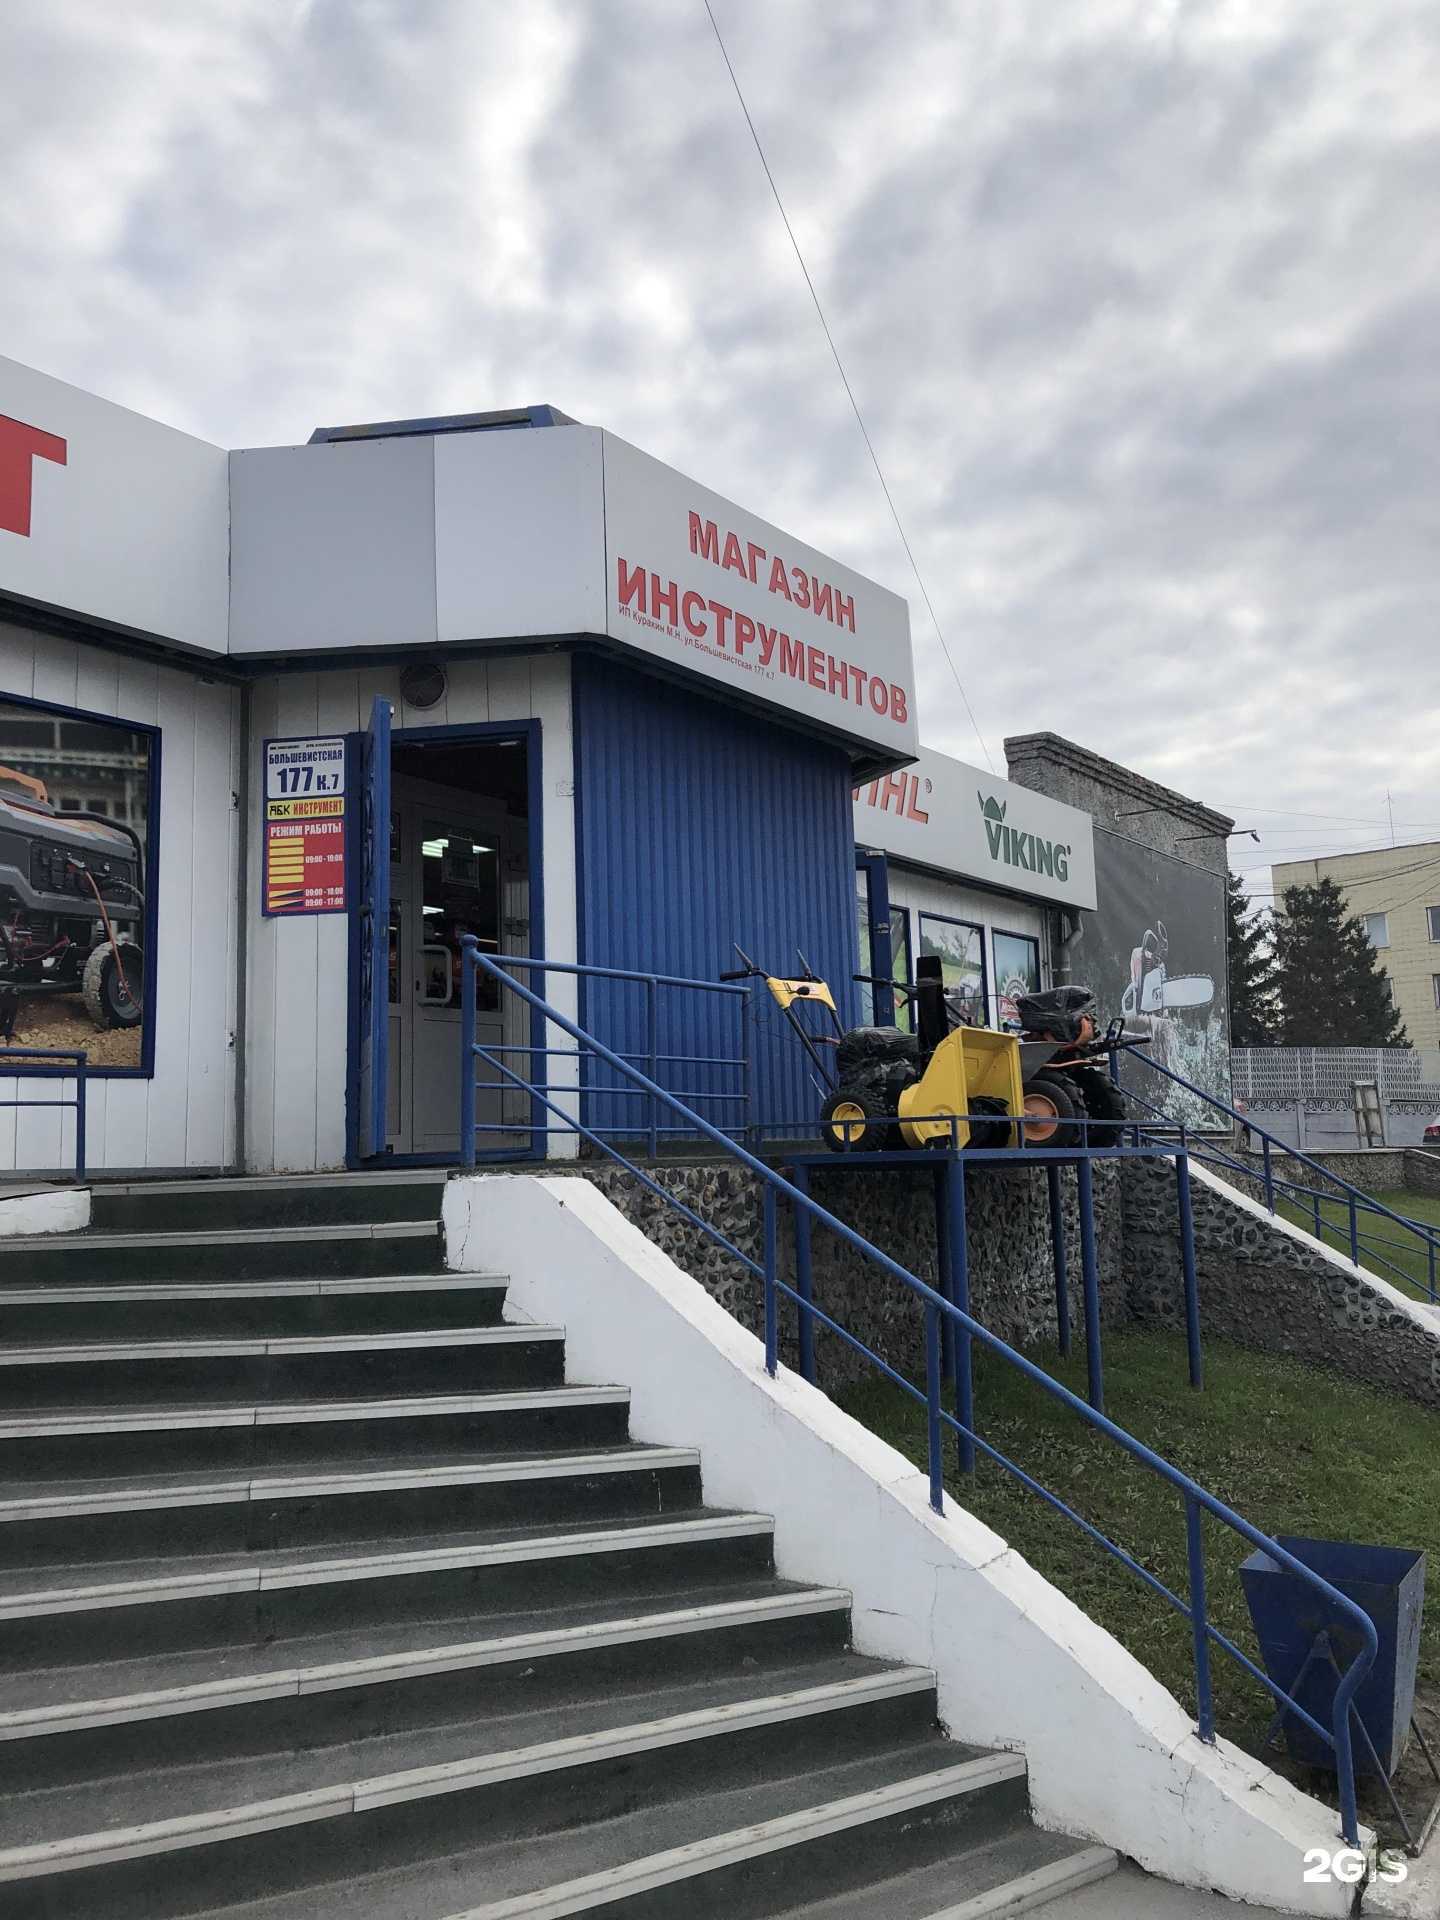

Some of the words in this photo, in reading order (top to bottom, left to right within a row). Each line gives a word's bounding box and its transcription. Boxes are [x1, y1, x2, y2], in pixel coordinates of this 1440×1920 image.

[688, 510, 856, 634] МАГАЗИН
[618, 604, 631, 617] ИП
[617, 557, 908, 724] ИНСТРУМЕНТОВ
[277, 767, 314, 793] 177
[852, 771, 929, 825] IHL
[269, 804, 291, 816] АБК
[293, 800, 343, 816] ИНСТРУМЕНТ
[270, 825, 303, 838] РЕЖИМ
[304, 822, 342, 835] РАБОТЫ
[984, 818, 1068, 883] VIKING
